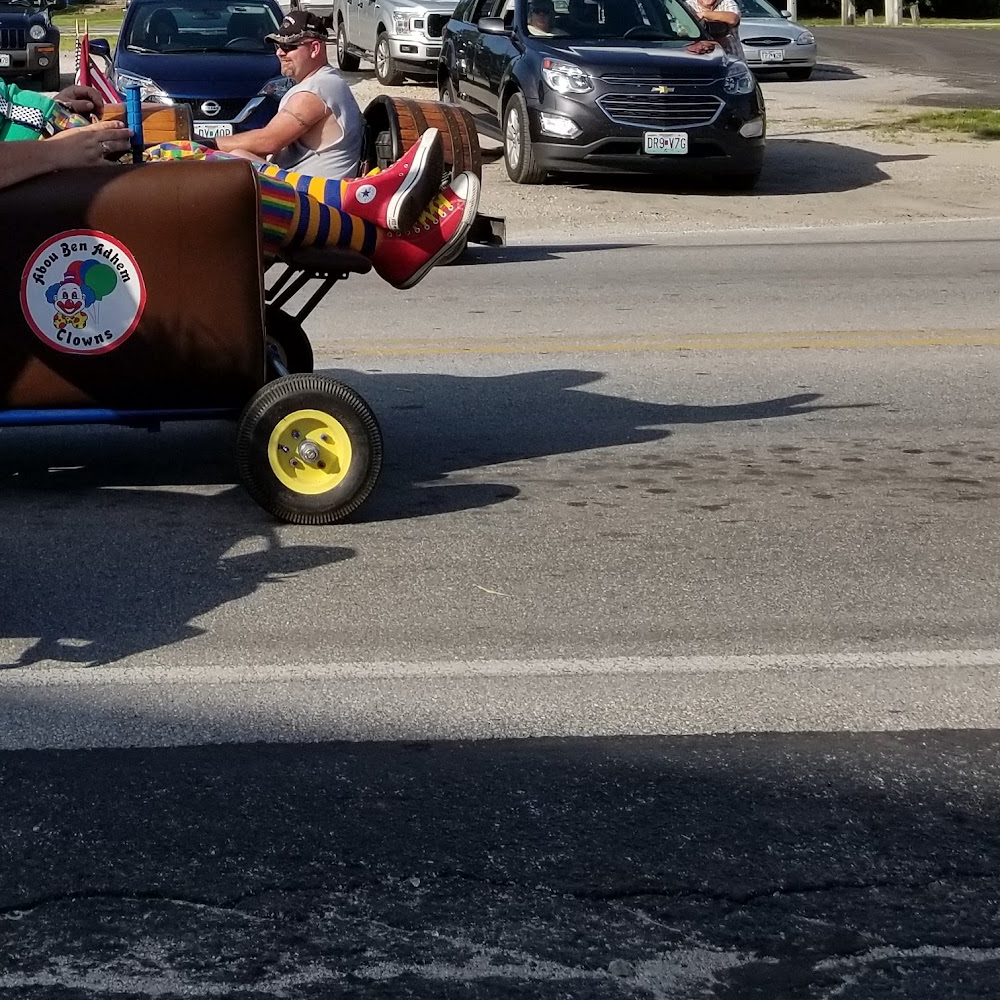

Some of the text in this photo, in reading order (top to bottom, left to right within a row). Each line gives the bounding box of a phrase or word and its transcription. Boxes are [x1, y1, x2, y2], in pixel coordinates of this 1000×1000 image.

[32, 242, 131, 286] Abou Ben Adhem
[56, 329, 113, 347] Clowns
